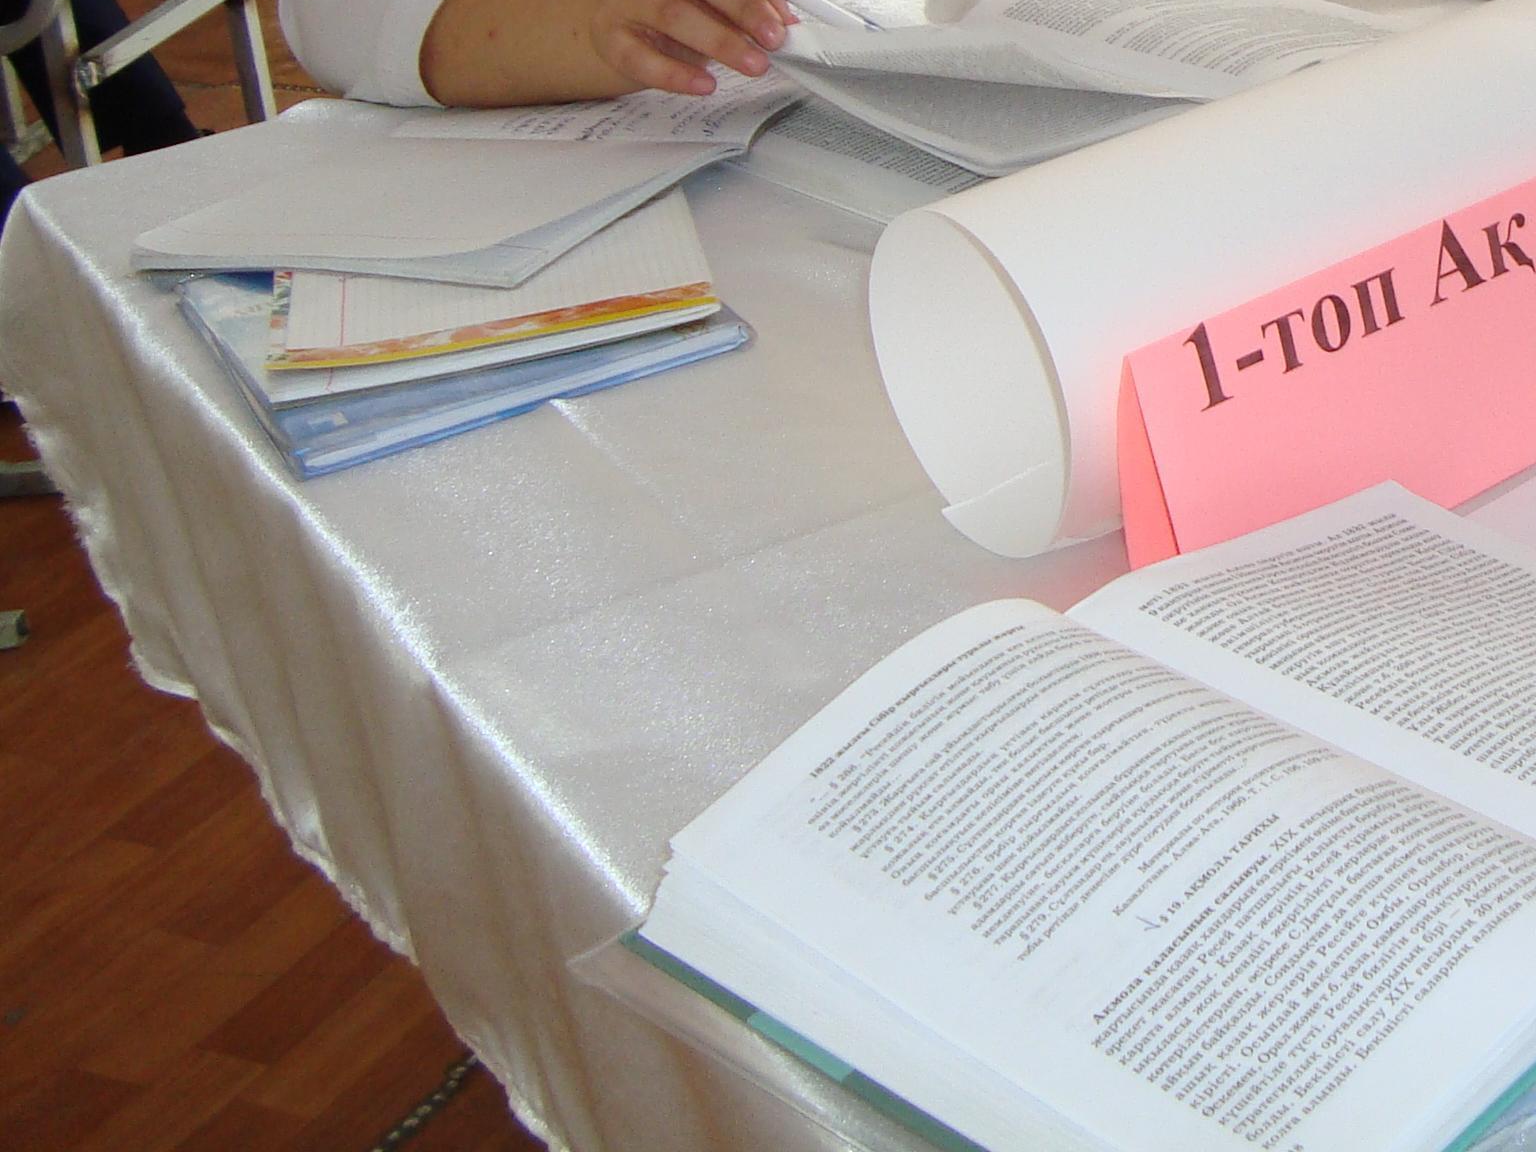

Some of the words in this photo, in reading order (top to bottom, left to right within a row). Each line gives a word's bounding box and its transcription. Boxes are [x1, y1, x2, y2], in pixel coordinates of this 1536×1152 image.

[1183, 267, 1406, 412] 1-топ
[1430, 218, 1536, 307] Ақ
[1227, 812, 1280, 856] ТАРИХЫ
[1305, 848, 1343, 880] Ресей
[1198, 927, 1235, 965] Ресей
[1092, 975, 1143, 1025] Ақмола
[1323, 979, 1364, 1020] Ресей
[1239, 997, 1301, 1059] Осындай
[1256, 1031, 1292, 1065] Орал
[1244, 1101, 1295, 1144] болды.
[1355, 1006, 1389, 1039] салу
[1384, 975, 1416, 1007] XIX
